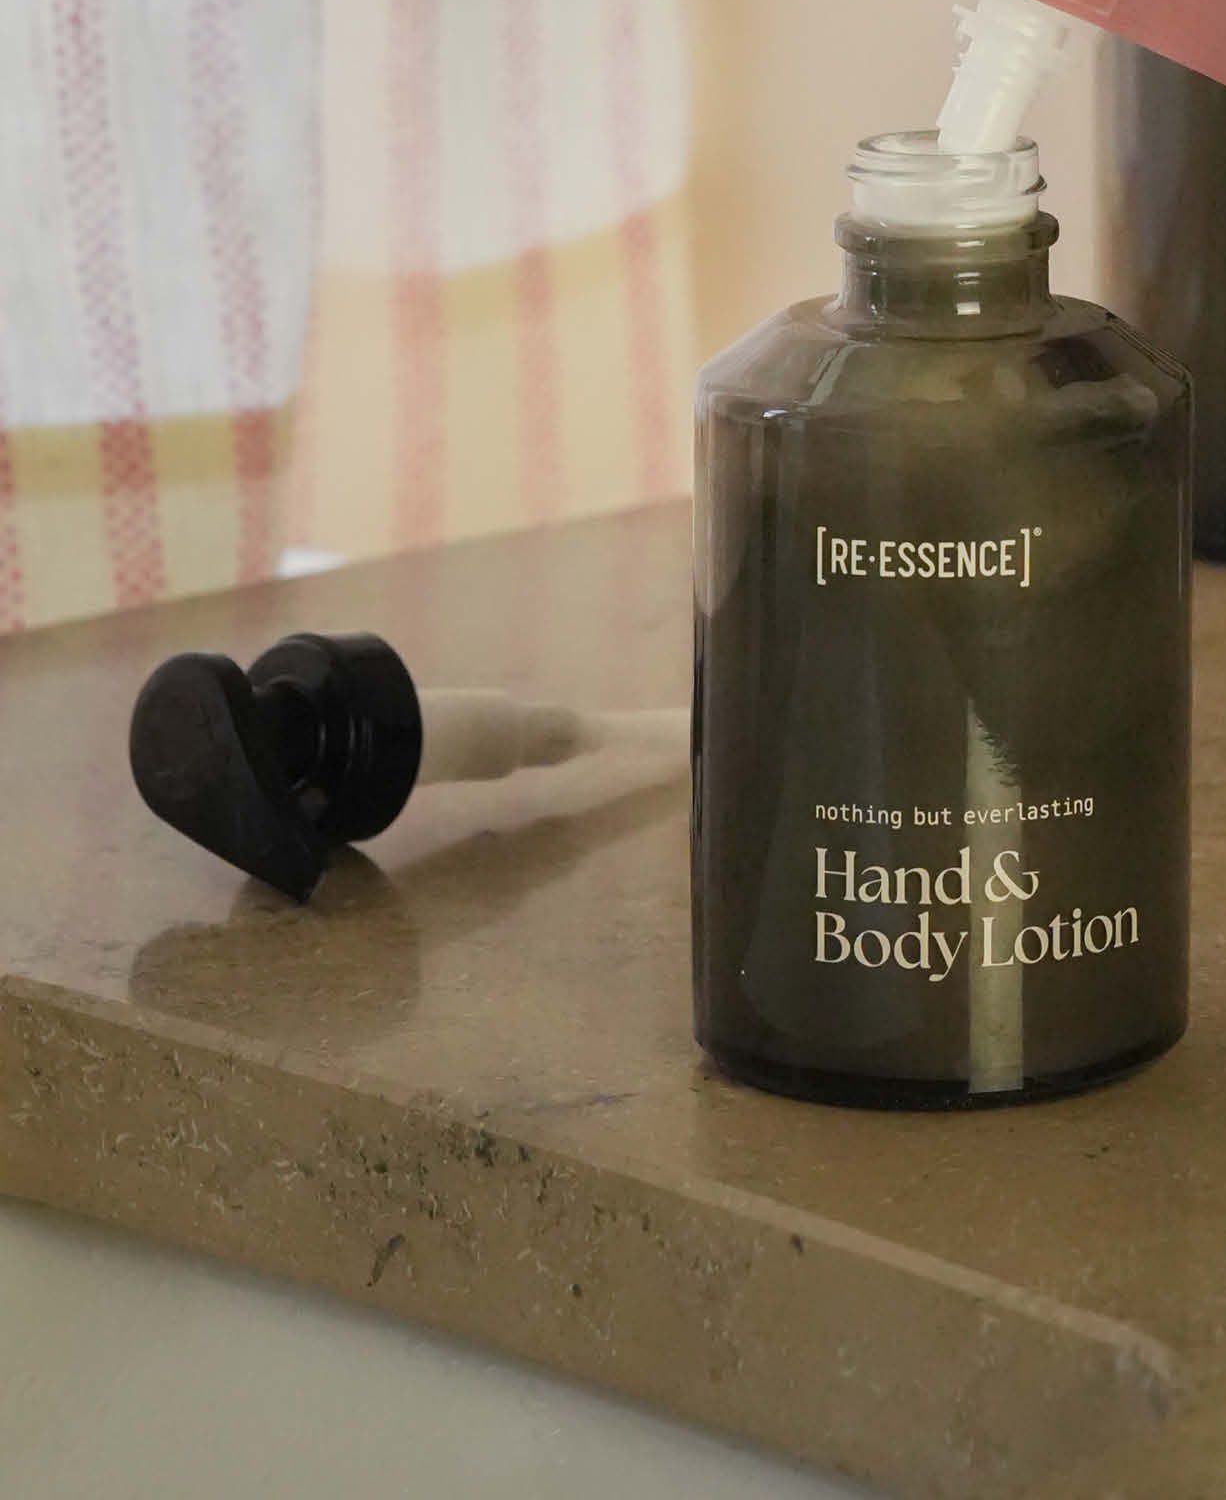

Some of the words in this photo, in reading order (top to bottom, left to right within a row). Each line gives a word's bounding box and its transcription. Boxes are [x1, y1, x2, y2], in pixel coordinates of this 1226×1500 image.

[814, 802, 903, 830] nothing
[913, 805, 953, 827] but
[962, 796, 1095, 826] everlasting
[814, 846, 973, 906] Hand
[983, 849, 1041, 903] &
[814, 910, 969, 983] Body
[980, 905, 1140, 969] Lotion
